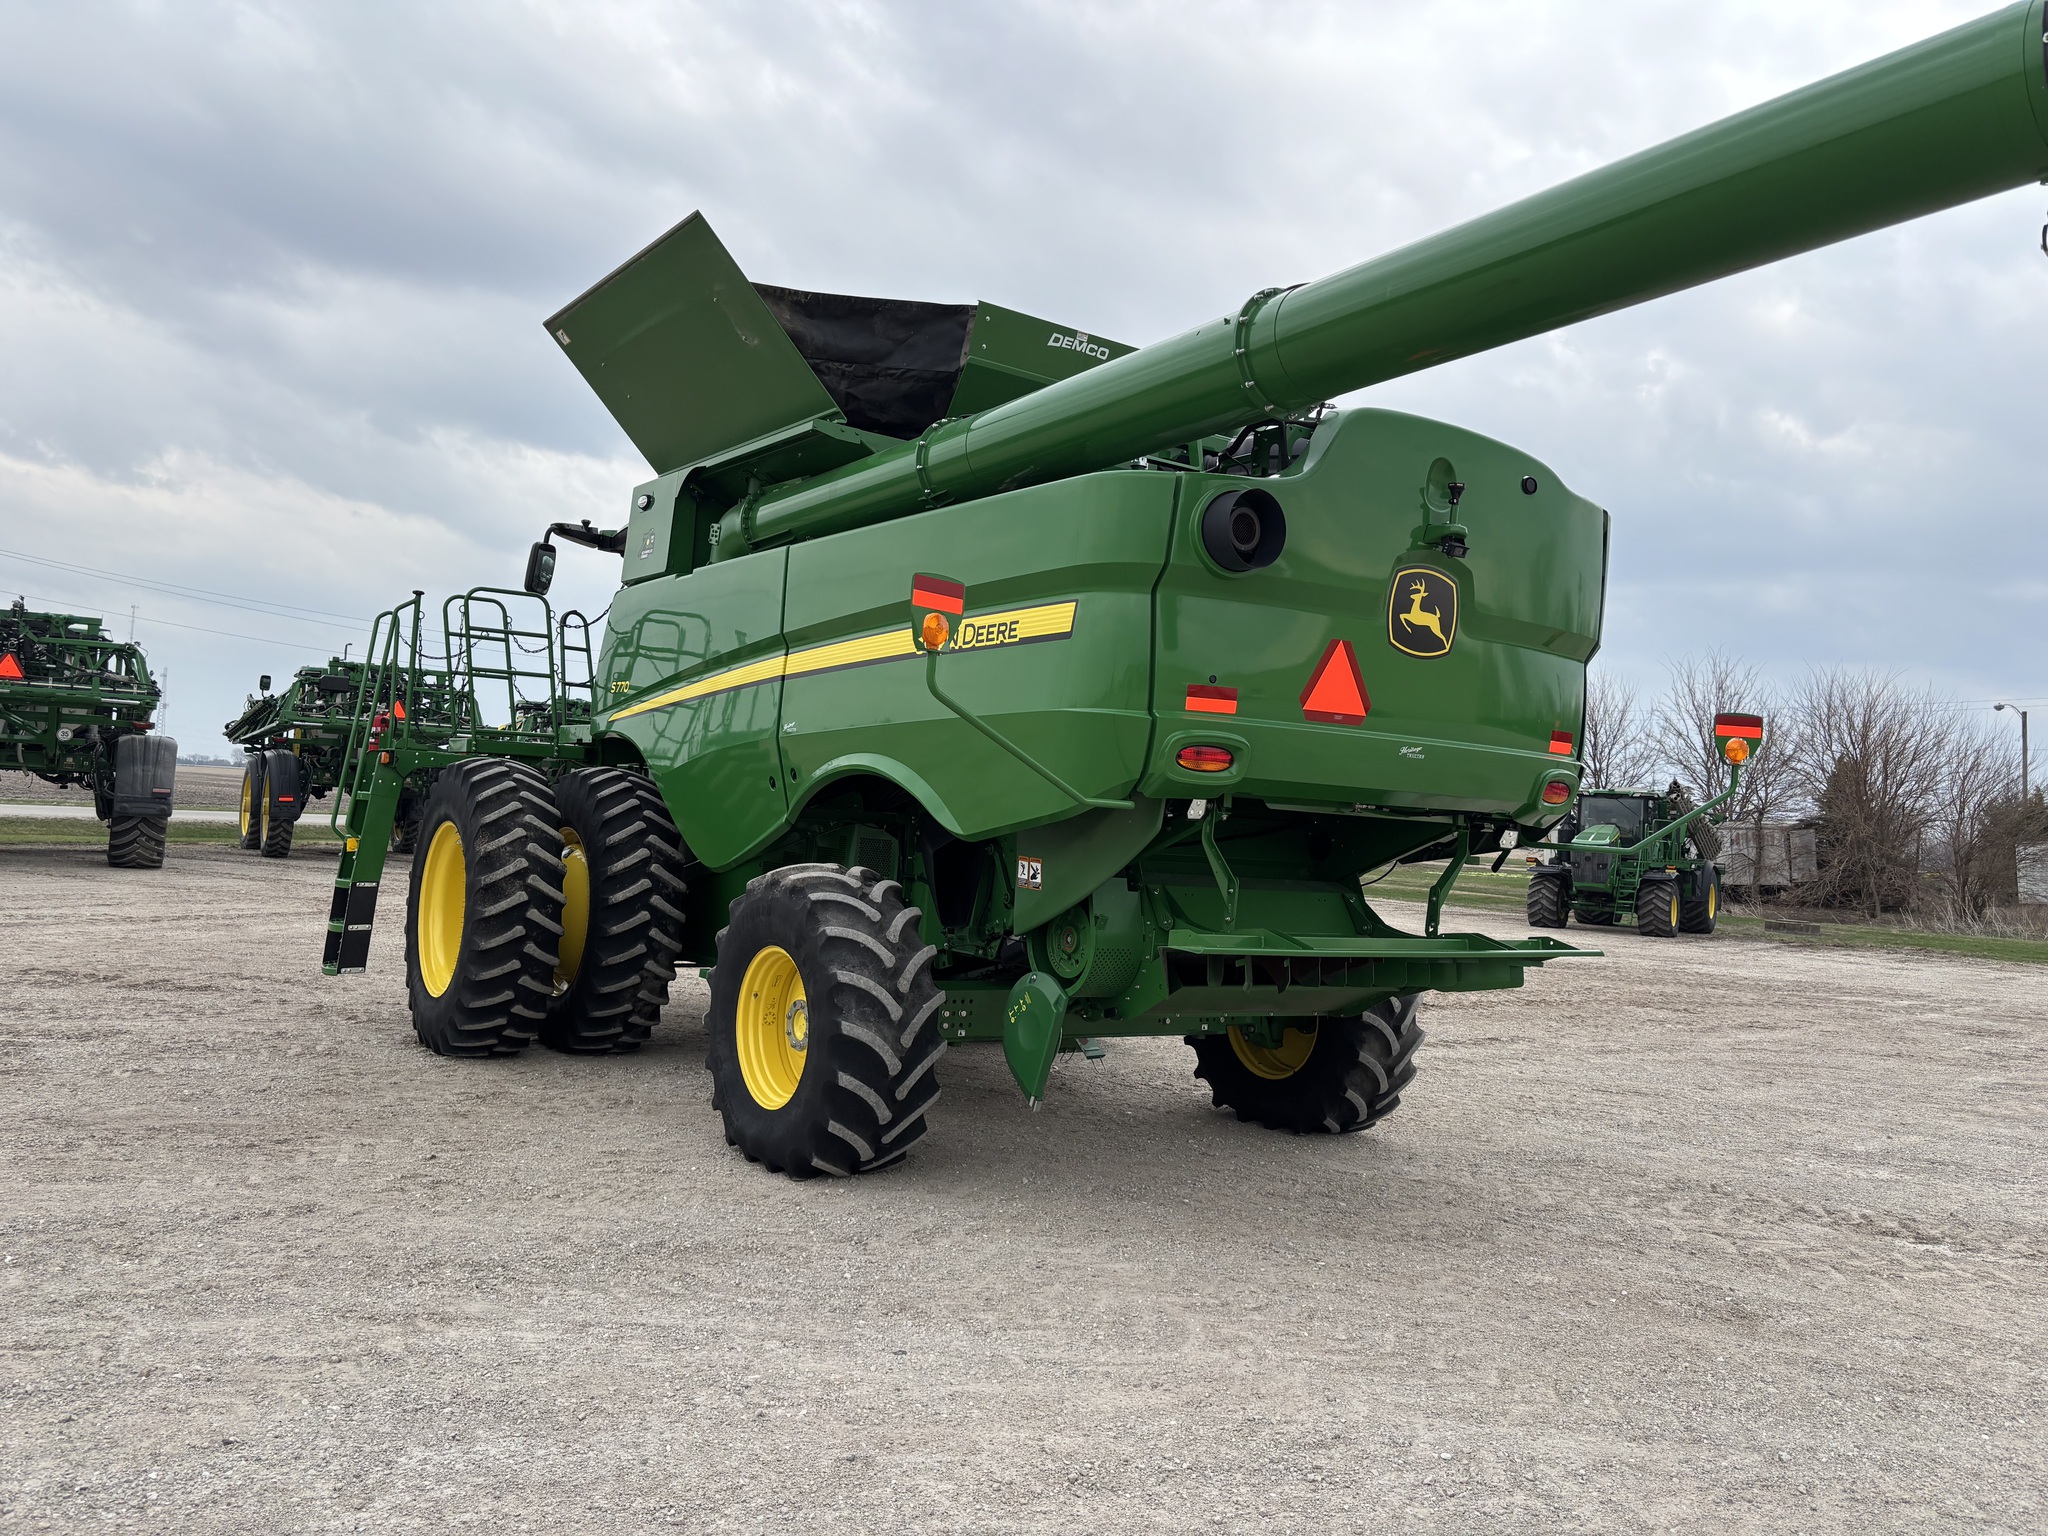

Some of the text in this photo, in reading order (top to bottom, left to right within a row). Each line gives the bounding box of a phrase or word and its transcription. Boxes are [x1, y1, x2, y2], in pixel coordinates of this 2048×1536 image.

[1047, 332, 1110, 361] DEMCO
[962, 620, 1020, 646] DEERE
[611, 681, 630, 694] S770
